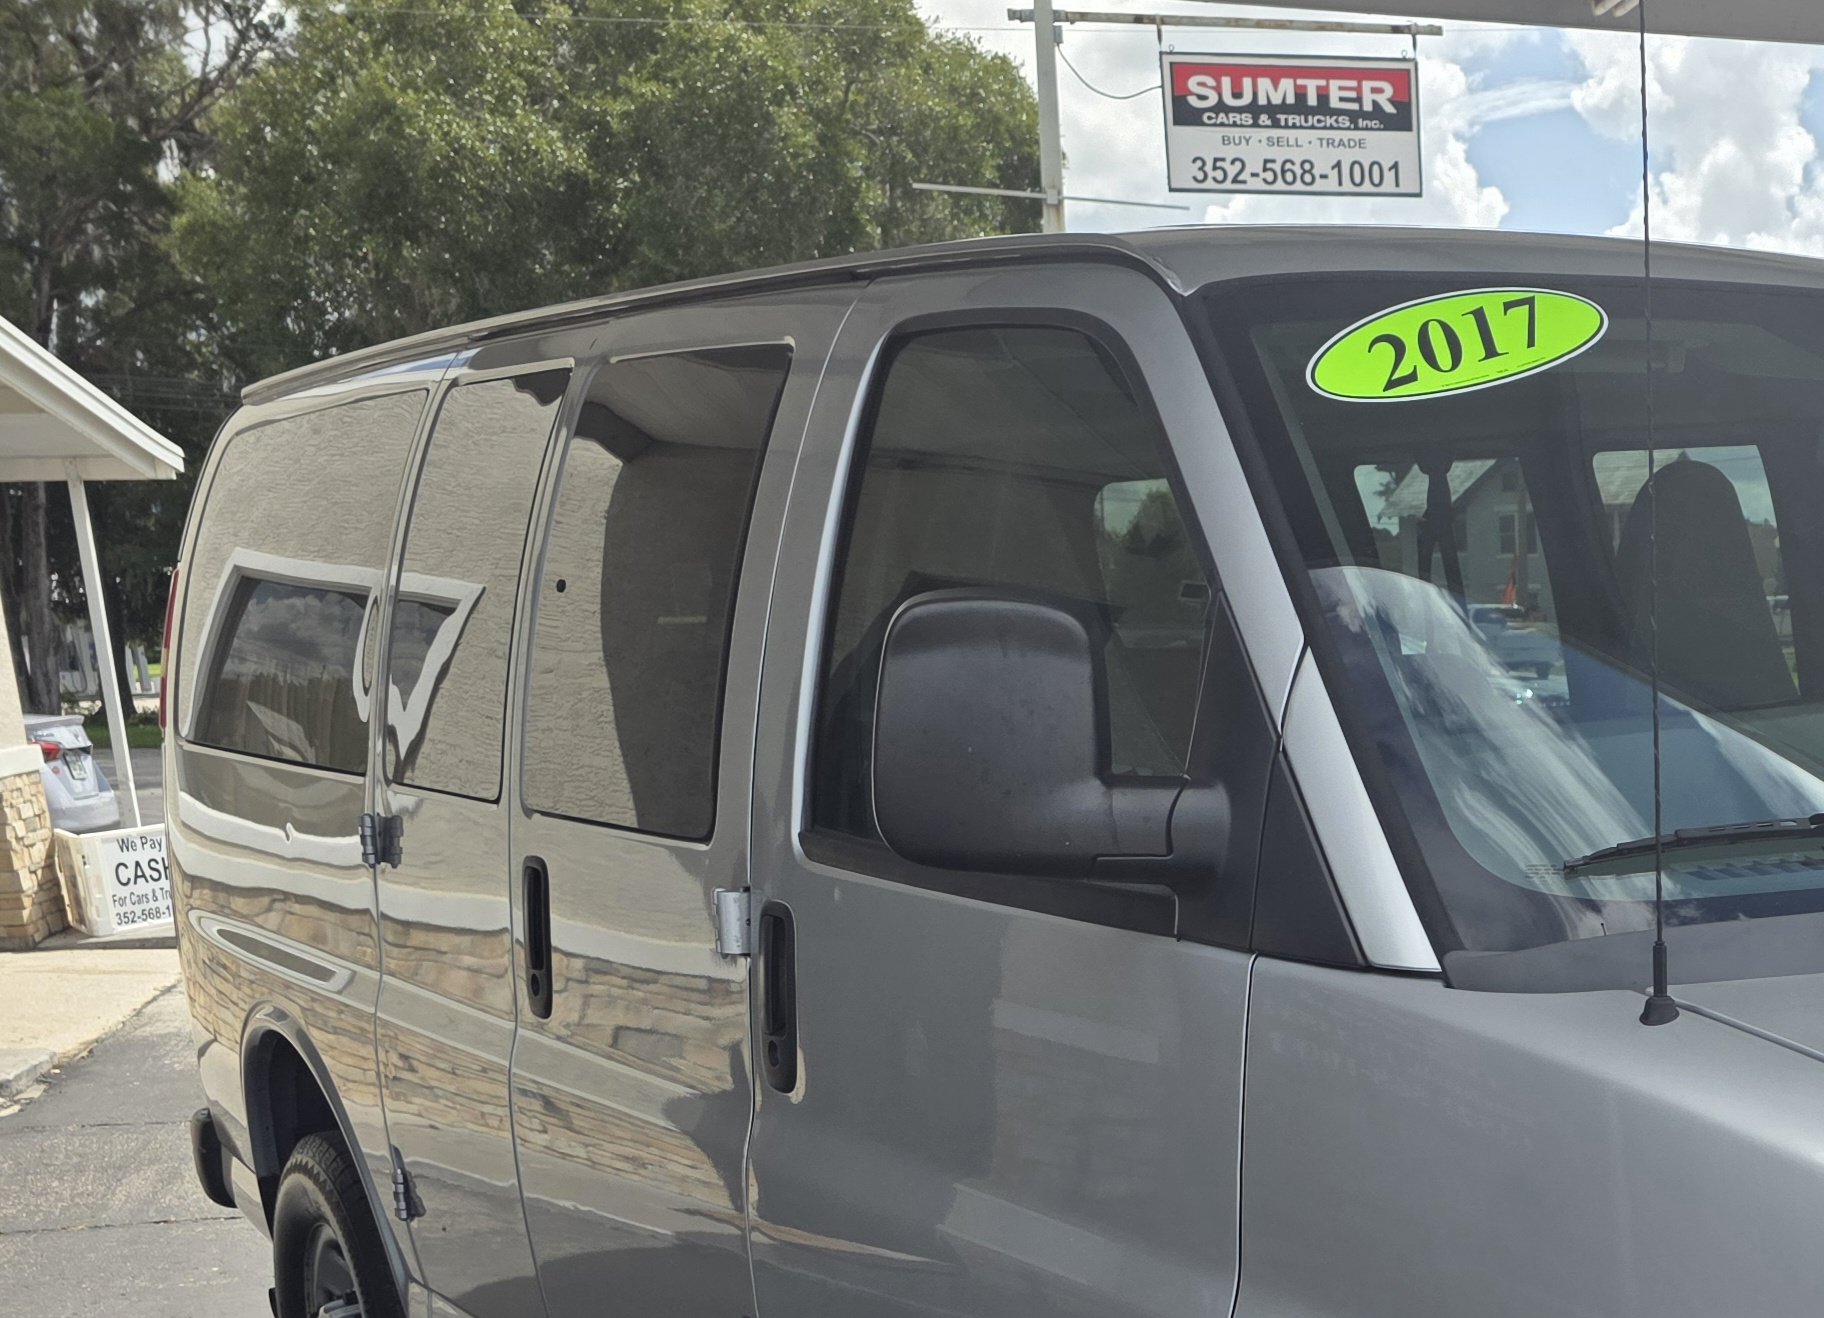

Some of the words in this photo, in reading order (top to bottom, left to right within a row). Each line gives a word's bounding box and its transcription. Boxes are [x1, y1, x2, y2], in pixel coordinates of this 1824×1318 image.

[1186, 74, 1398, 114] SUMTER
[1202, 111, 1253, 126] CARS
[1258, 113, 1272, 126] &
[1358, 119, 1384, 129] Inc.
[1221, 135, 1252, 147] BUY
[1266, 136, 1303, 148] SELL
[1317, 137, 1368, 149] TRADE
[1191, 156, 1401, 188] 352-568-1001
[1367, 296, 1536, 392] 2017
[116, 837, 137, 853] We
[140, 835, 162, 853] Pay
[112, 894, 127, 908] For
[129, 891, 150, 906] Cars
[152, 888, 158, 902] &
